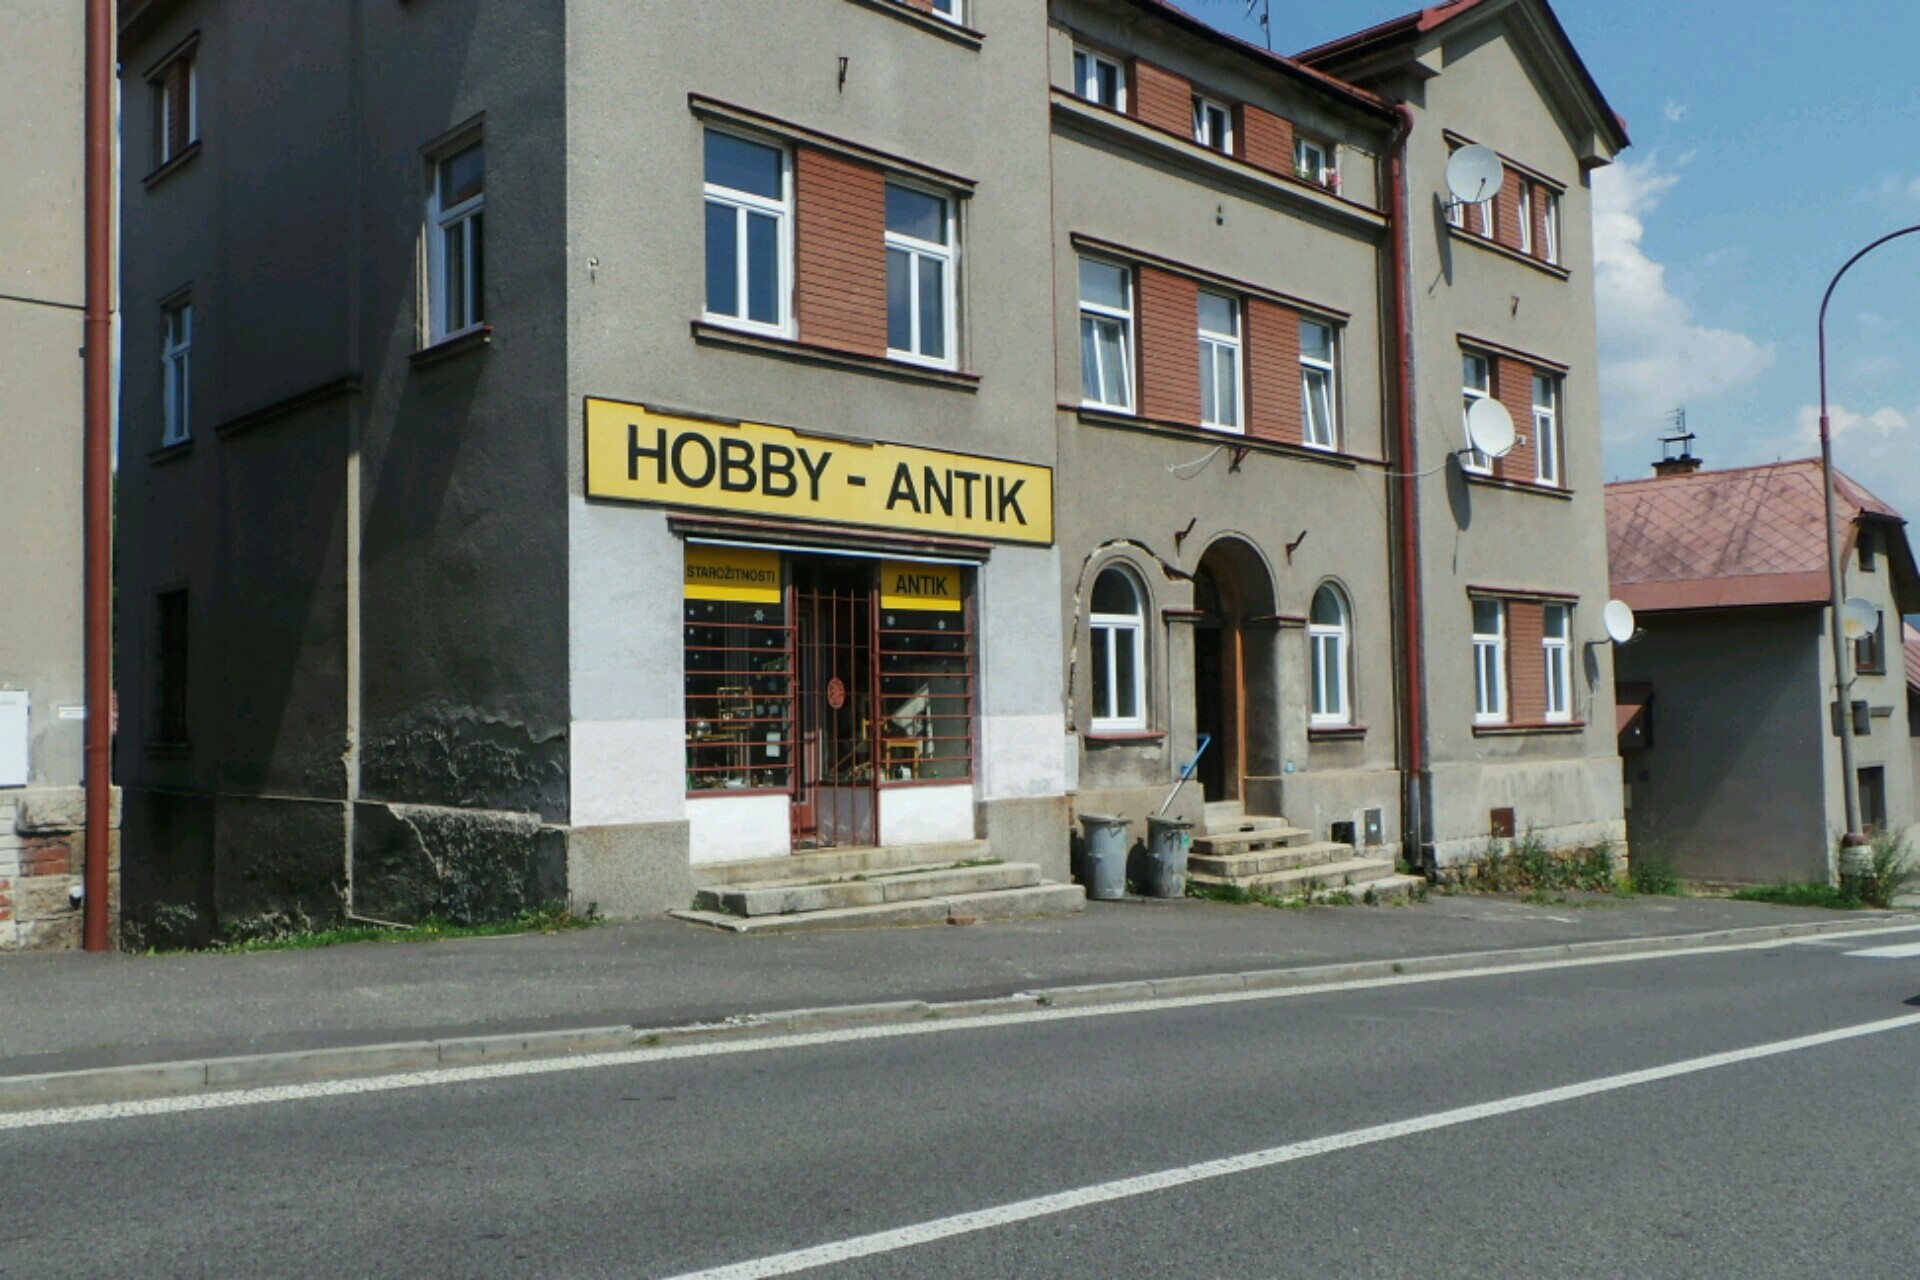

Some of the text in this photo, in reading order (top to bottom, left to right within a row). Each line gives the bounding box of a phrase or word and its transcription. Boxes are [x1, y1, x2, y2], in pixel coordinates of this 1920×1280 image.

[627, 424, 832, 502] HOBBY
[886, 462, 1027, 526] ANTIK
[686, 565, 776, 583] STAROŽITNOSTI
[895, 574, 948, 595] ANTIK
